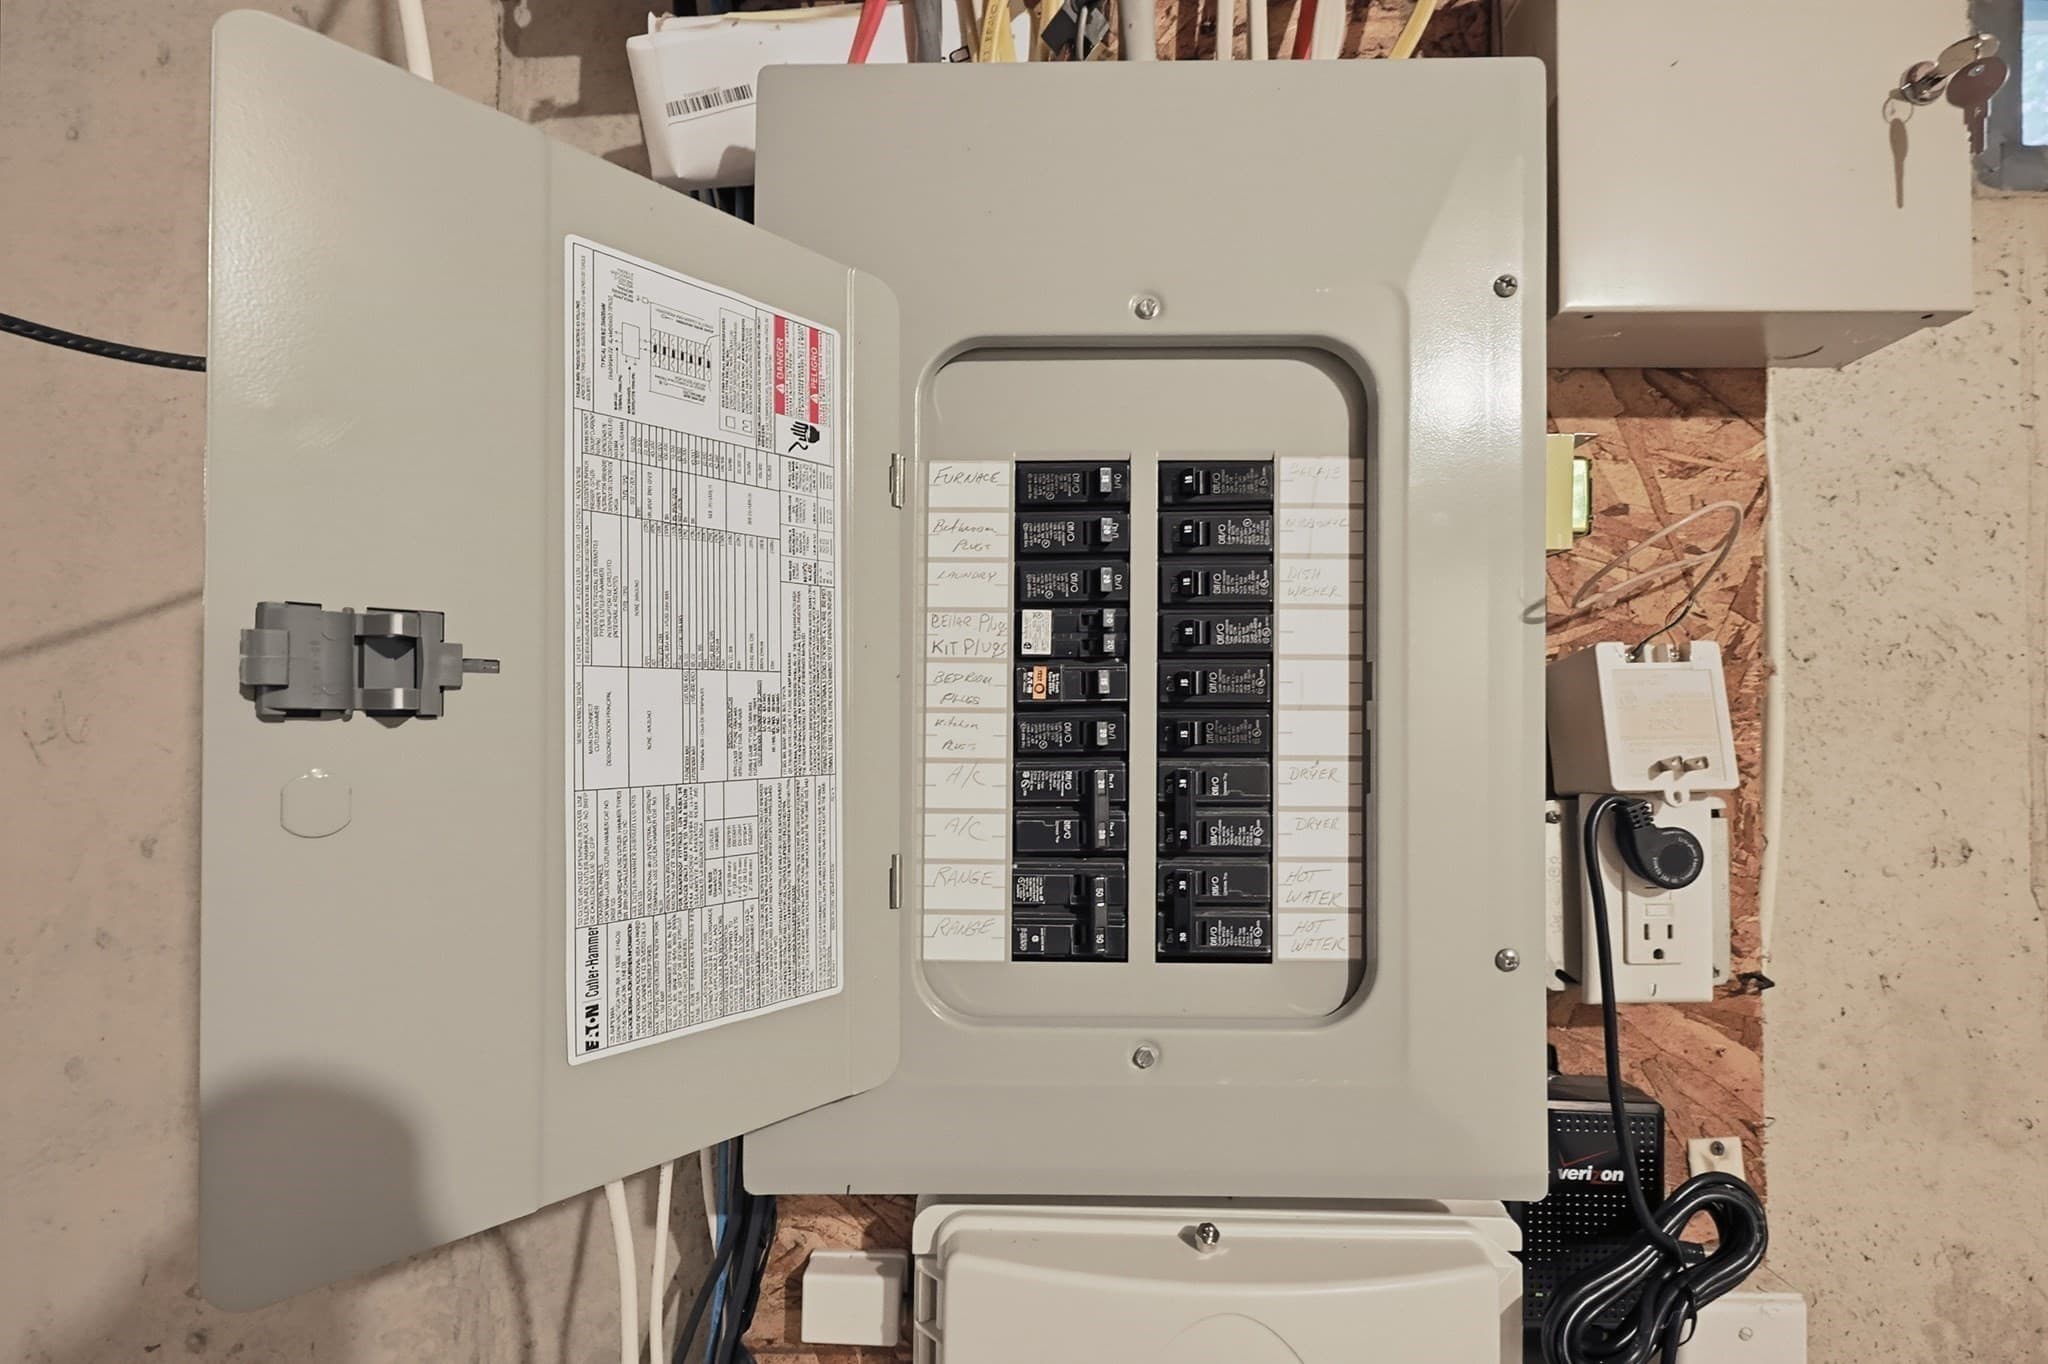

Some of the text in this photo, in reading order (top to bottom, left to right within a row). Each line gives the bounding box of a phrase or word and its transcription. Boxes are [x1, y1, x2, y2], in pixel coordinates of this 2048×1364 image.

[776, 338, 784, 379] DANGER
[810, 347, 818, 389] PELIGRO
[933, 465, 1001, 485] FURNACE
[1107, 640, 1114, 649] 20
[945, 763, 986, 790] A/C
[1288, 766, 1340, 782] DRYER
[944, 815, 987, 842] A/C
[1295, 817, 1341, 831] DRYER
[932, 866, 993, 887] RANGE
[1286, 868, 1333, 883] HOT
[1096, 888, 1104, 897] 50
[1285, 889, 1343, 907] WATER
[932, 917, 996, 938] RANGE
[1293, 918, 1337, 936] HOT
[1096, 934, 1104, 943] 50
[585, 927, 599, 997] Cutler-Hammer
[1558, 1165, 1625, 1184] verizon
